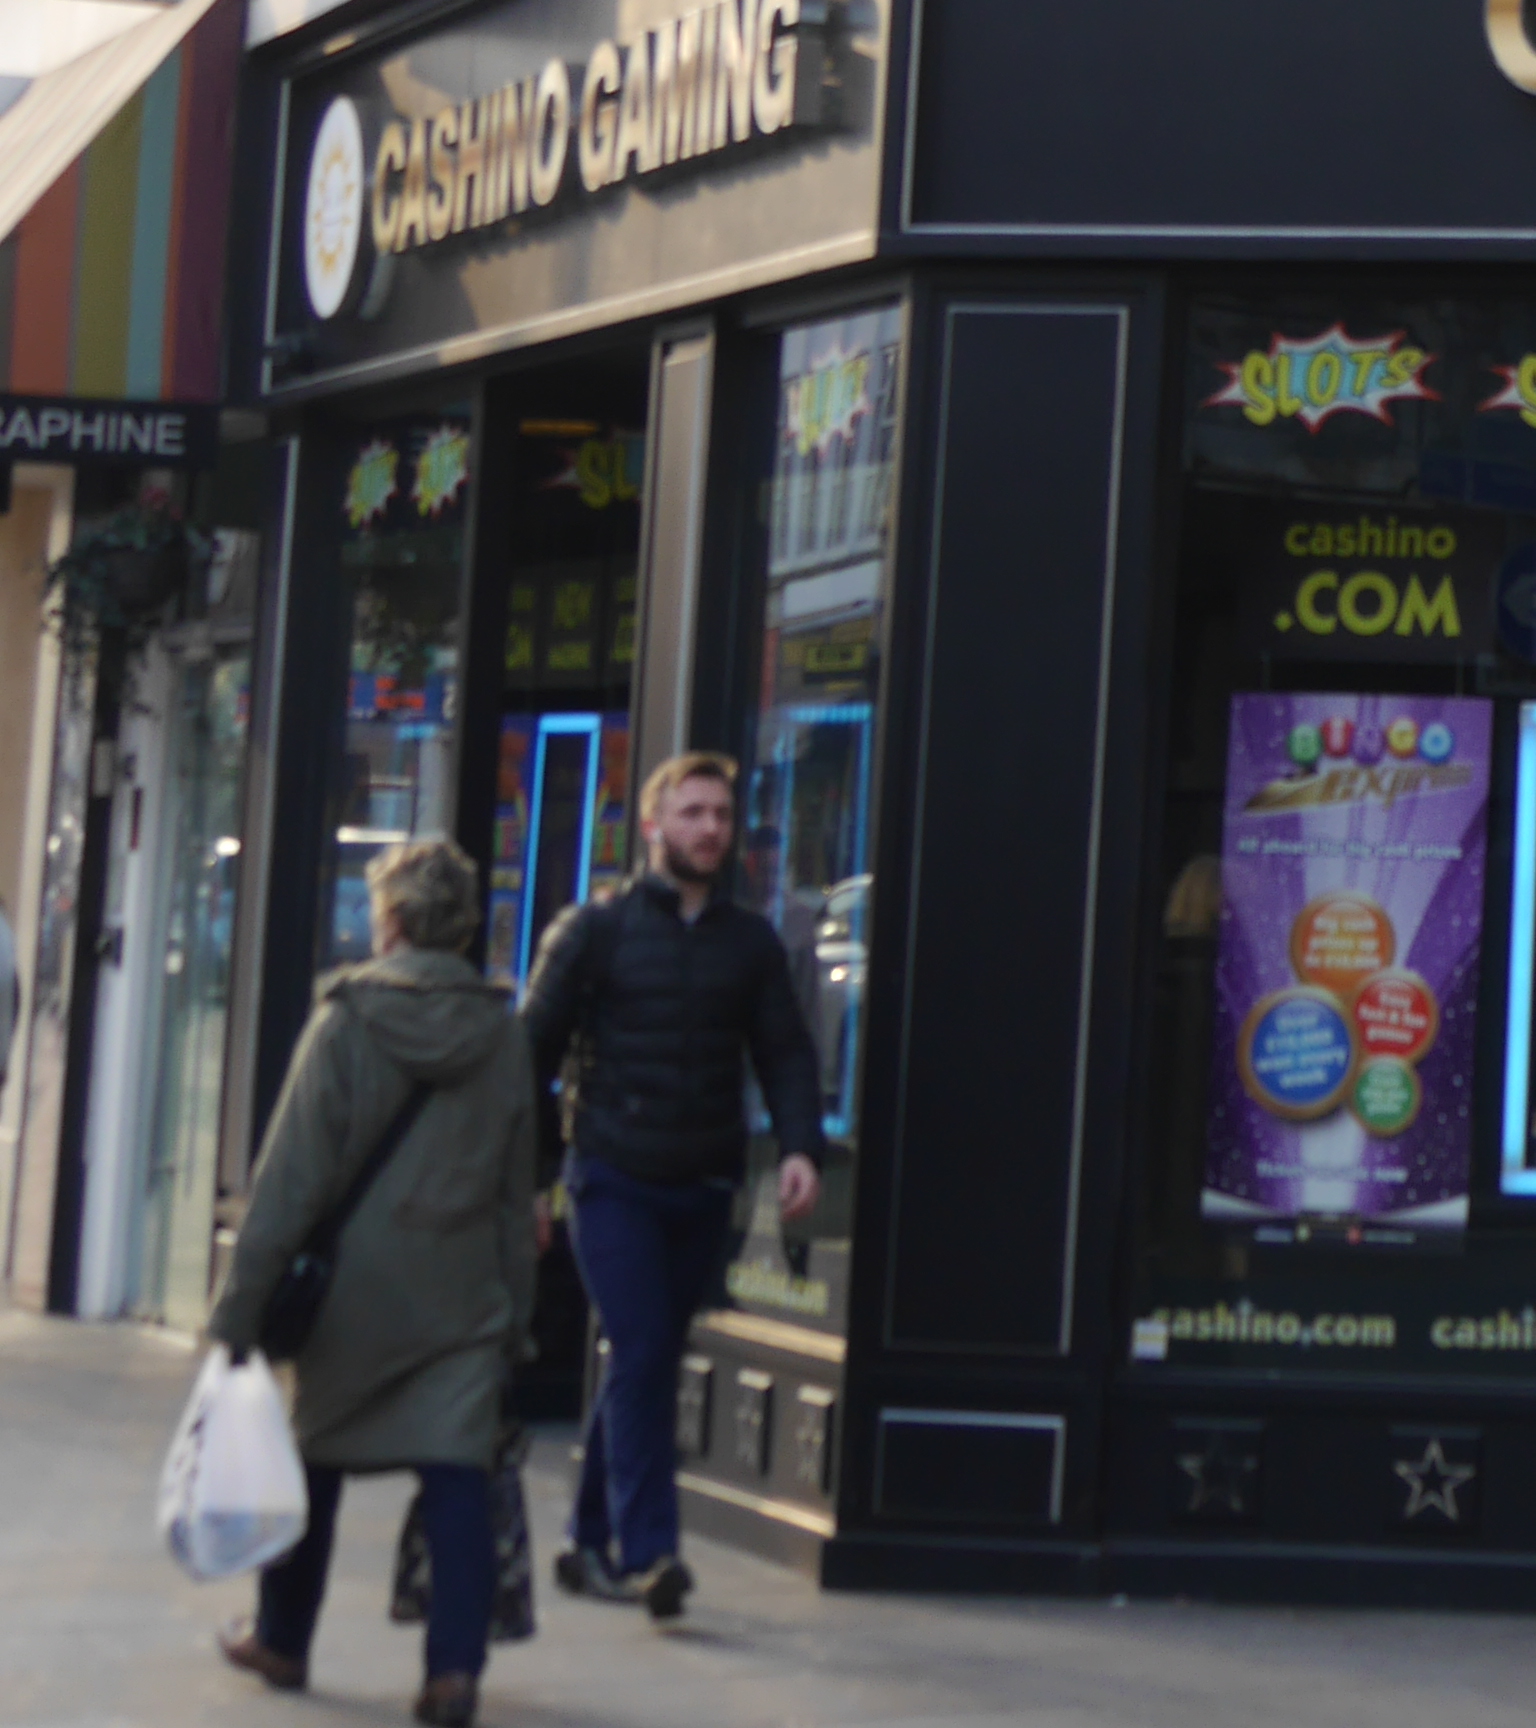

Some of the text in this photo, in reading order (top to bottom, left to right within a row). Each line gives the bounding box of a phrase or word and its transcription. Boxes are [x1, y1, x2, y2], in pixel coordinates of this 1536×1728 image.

[372, 58, 569, 254] CASHINO
[1241, 346, 1424, 427] SLOTS
[1284, 516, 1457, 560] cashino
[1274, 571, 1461, 639] .COM
